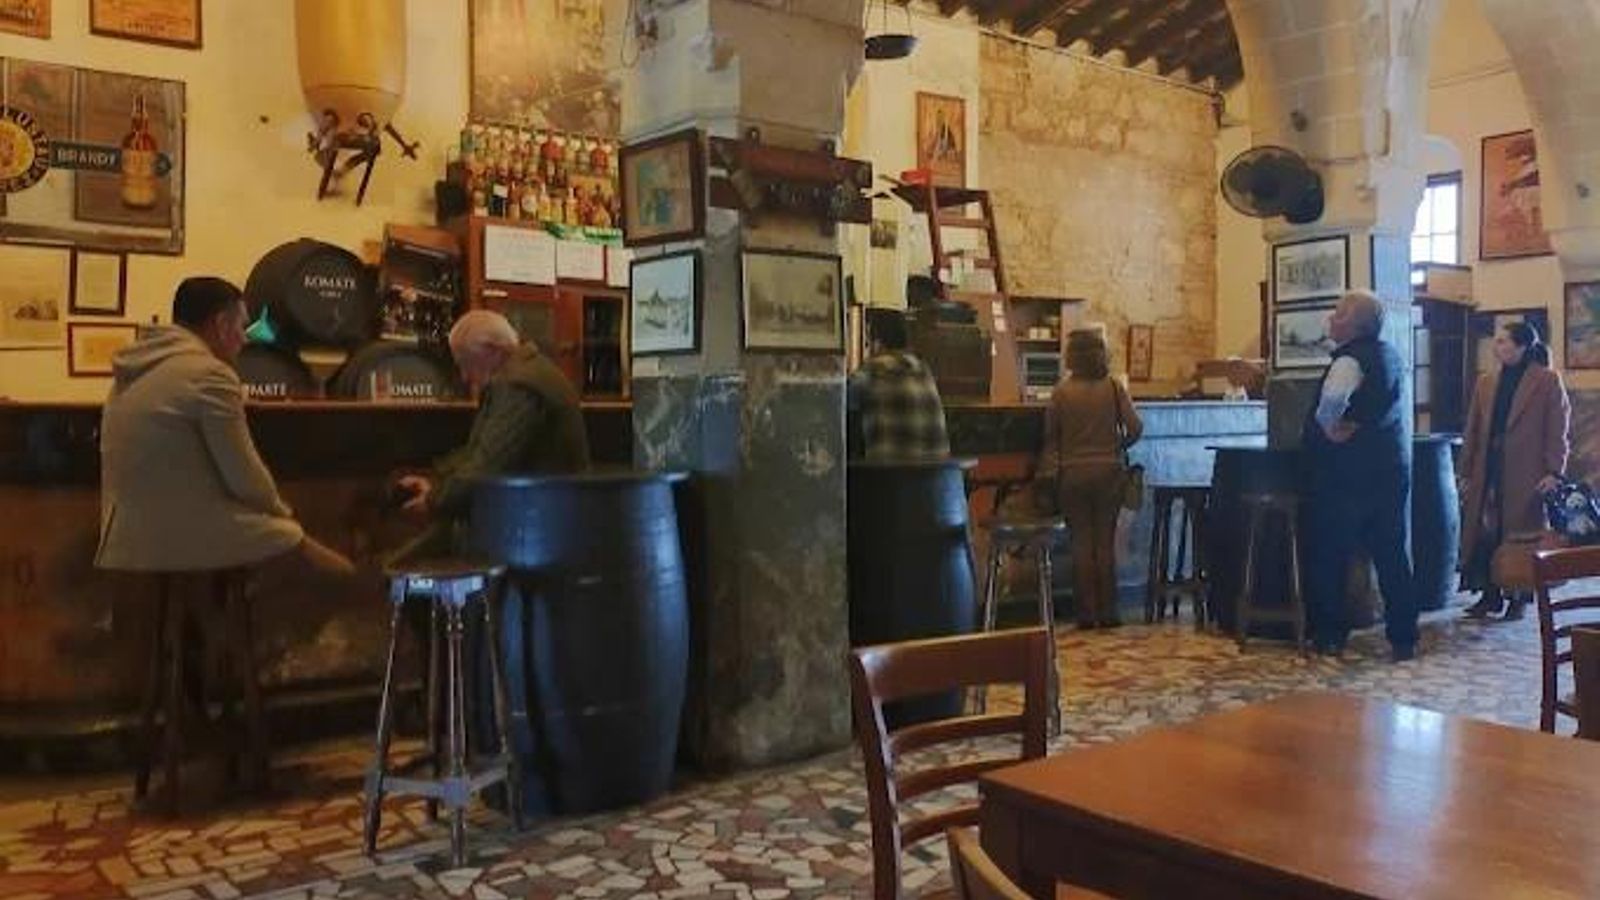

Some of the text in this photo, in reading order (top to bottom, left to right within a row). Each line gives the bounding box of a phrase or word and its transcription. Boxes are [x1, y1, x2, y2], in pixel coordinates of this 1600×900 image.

[57, 149, 117, 166] BRANDY
[304, 275, 357, 290] ROMATE
[391, 382, 433, 396] OMATE
